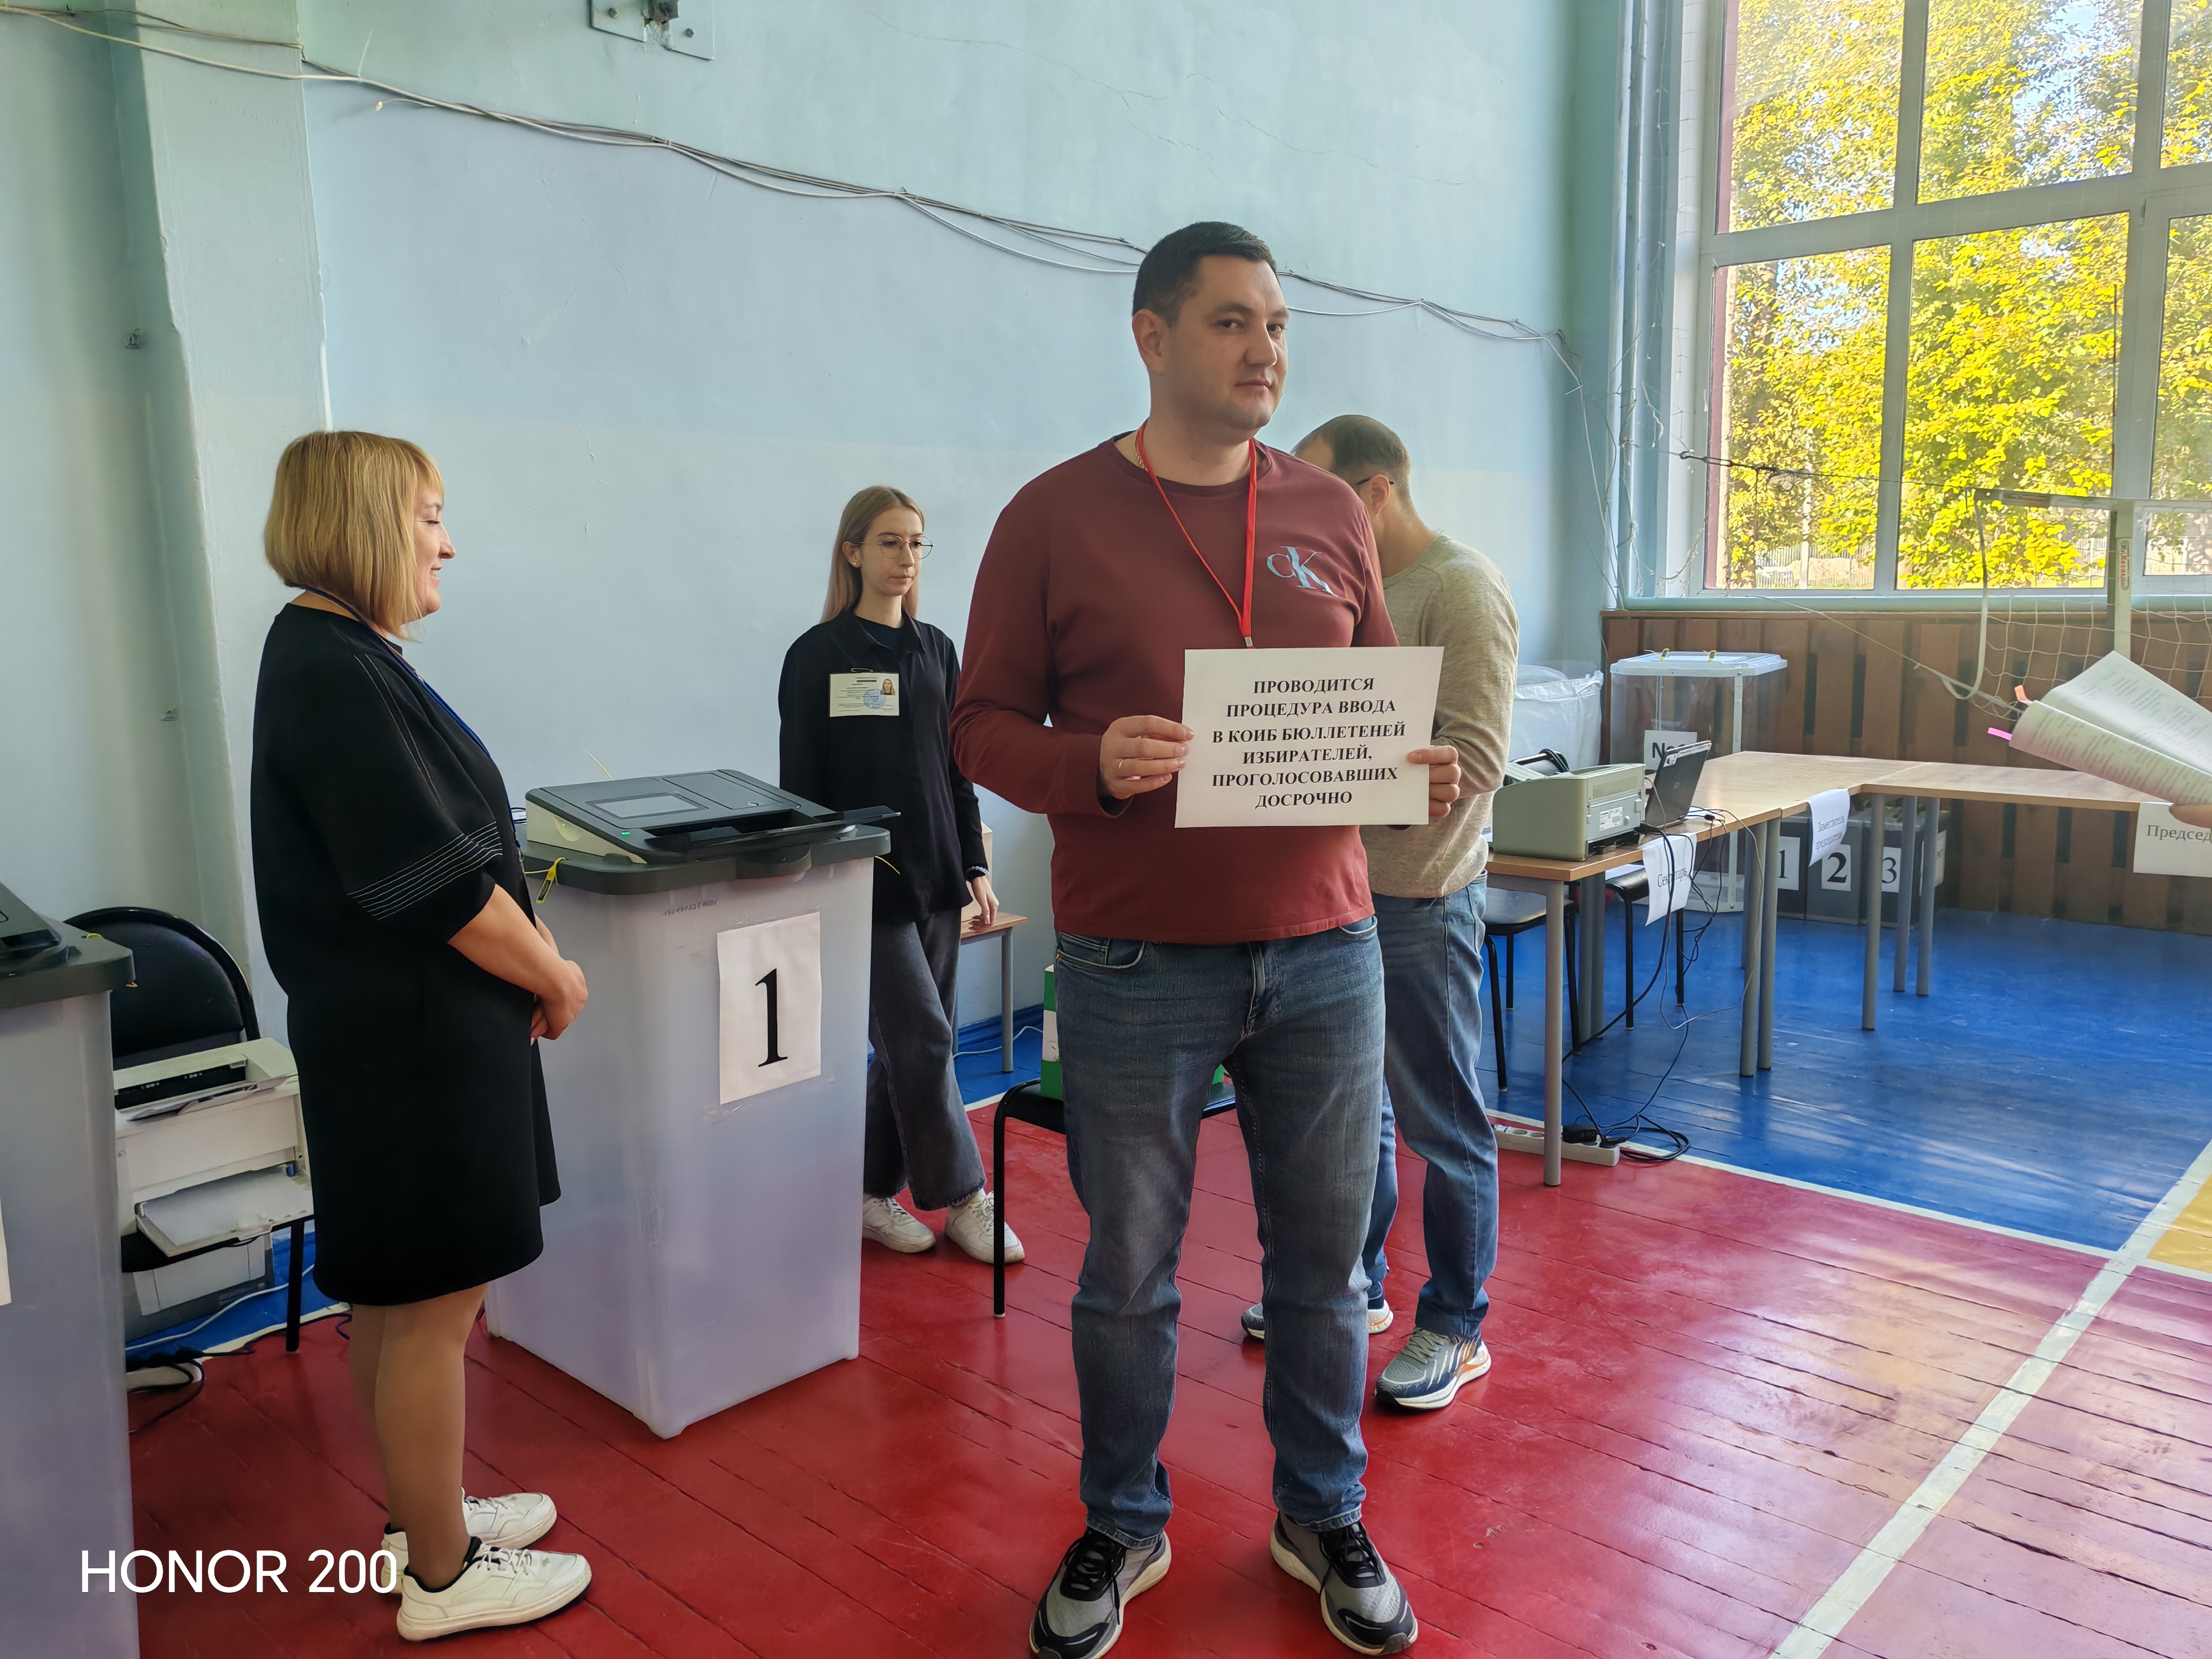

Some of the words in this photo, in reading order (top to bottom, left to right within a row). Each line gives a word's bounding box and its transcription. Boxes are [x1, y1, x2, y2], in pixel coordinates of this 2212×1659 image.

[1253, 678, 1374, 694] ПРОВОДИТСЯ
[1226, 702, 1333, 718] ПРОЦЕДУРА
[1338, 700, 1396, 714] ВВОДА
[1212, 731, 1223, 743] В
[1228, 728, 1277, 743] КОИБ
[1282, 721, 1406, 741] БЮЛЛЕТЕНЕЙ
[1243, 744, 1372, 765] ИЗБИРАТЕЛЕЙ,
[1212, 767, 1398, 787] ПРОГОЛОСОВАВШИХ
[1255, 791, 1352, 810] ДОСРОЧНО
[1778, 849, 1788, 879] 1
[1827, 852, 1847, 884] 2
[1882, 857, 1897, 884] 3
[755, 968, 788, 1068] 1
